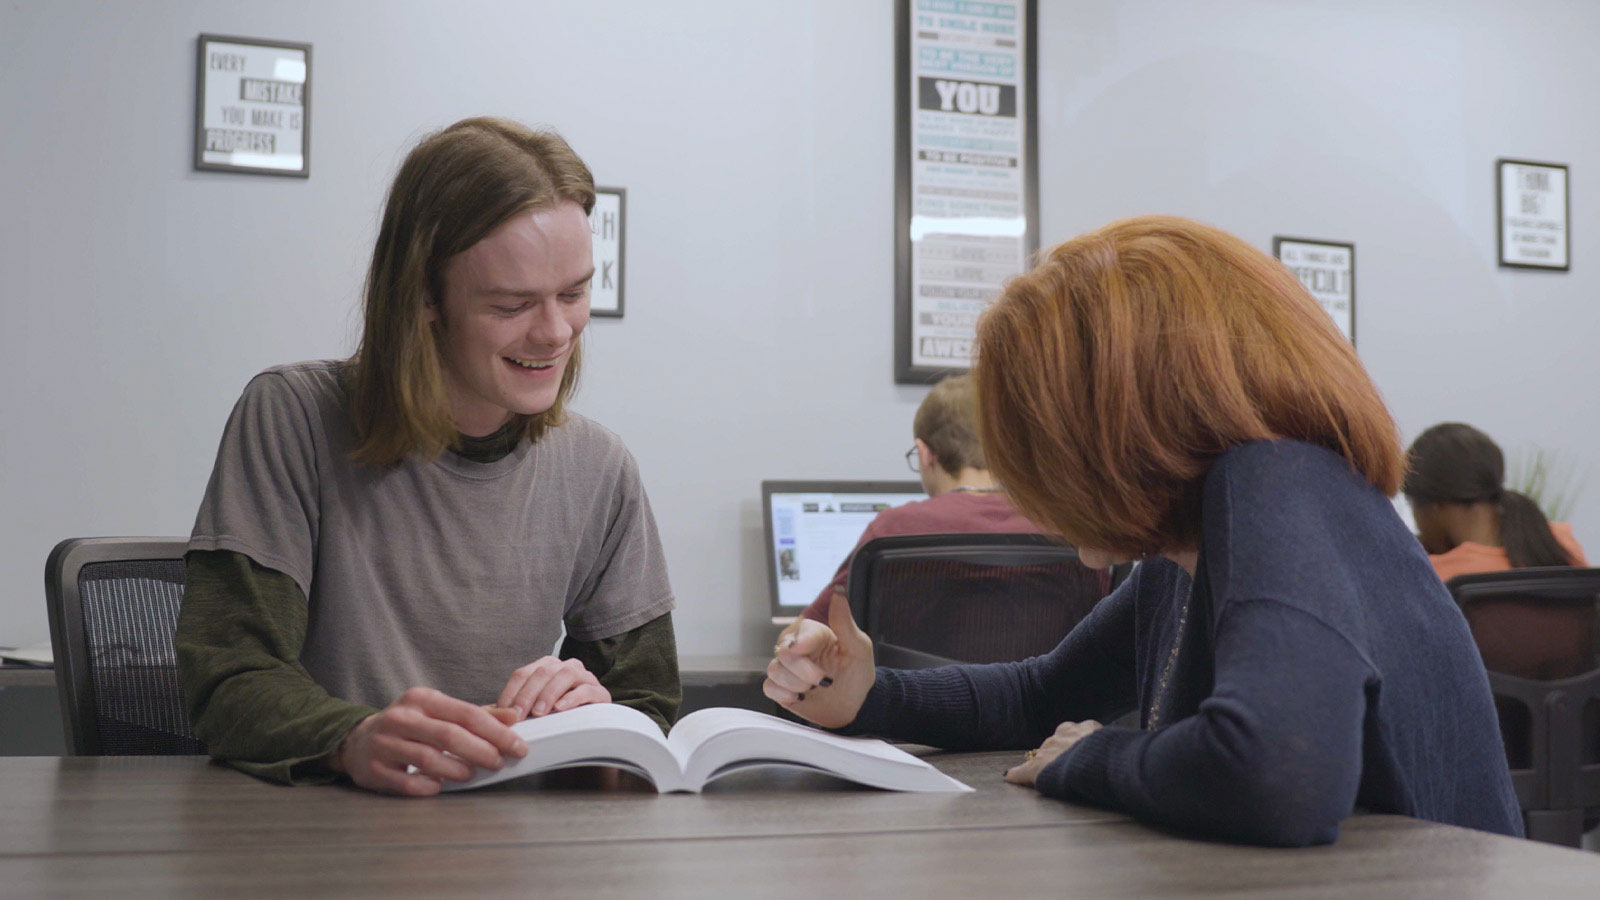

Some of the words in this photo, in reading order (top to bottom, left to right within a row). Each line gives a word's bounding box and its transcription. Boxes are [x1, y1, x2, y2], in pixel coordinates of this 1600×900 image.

[210, 52, 247, 72] EVERY
[244, 80, 302, 104] MISTAKE
[935, 80, 1000, 115] YOU
[221, 106, 246, 126] YOU
[252, 109, 282, 128] MAKE
[289, 112, 300, 130] IS
[206, 130, 273, 154] PROGRESS
